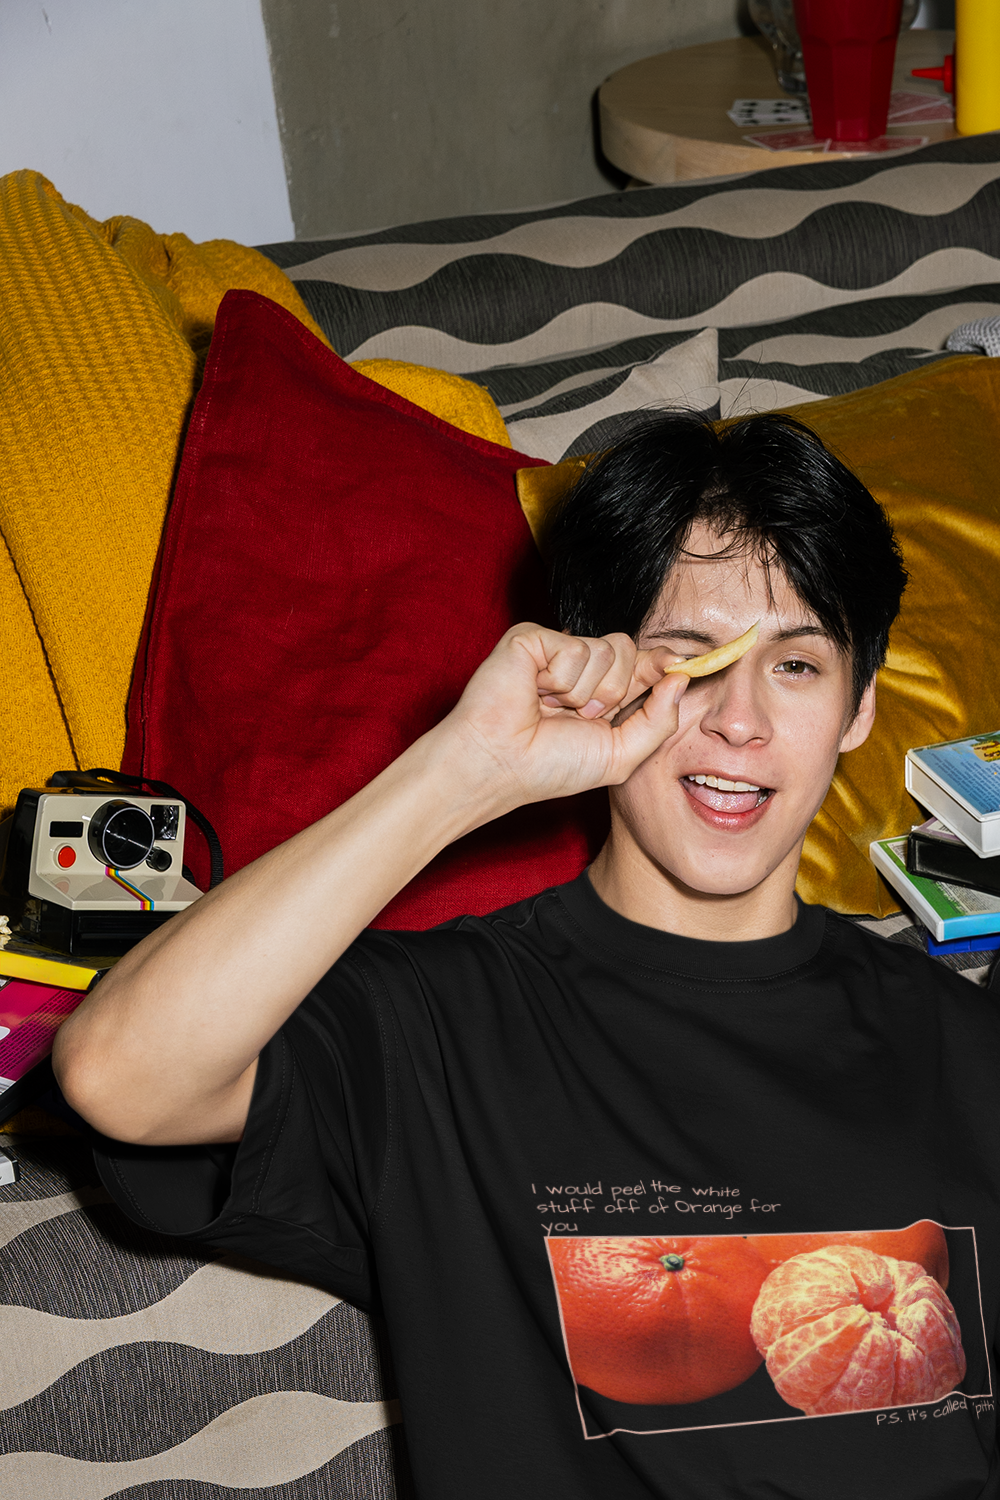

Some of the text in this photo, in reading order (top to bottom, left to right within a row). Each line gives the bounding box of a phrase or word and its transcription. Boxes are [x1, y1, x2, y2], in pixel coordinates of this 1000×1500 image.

[531, 1179, 741, 1201] I would peel the white
[536, 1196, 782, 1220] stuff off of Orange for
[540, 1221, 578, 1237] you
[907, 1409, 927, 1421] it's
[933, 1396, 968, 1418] called
